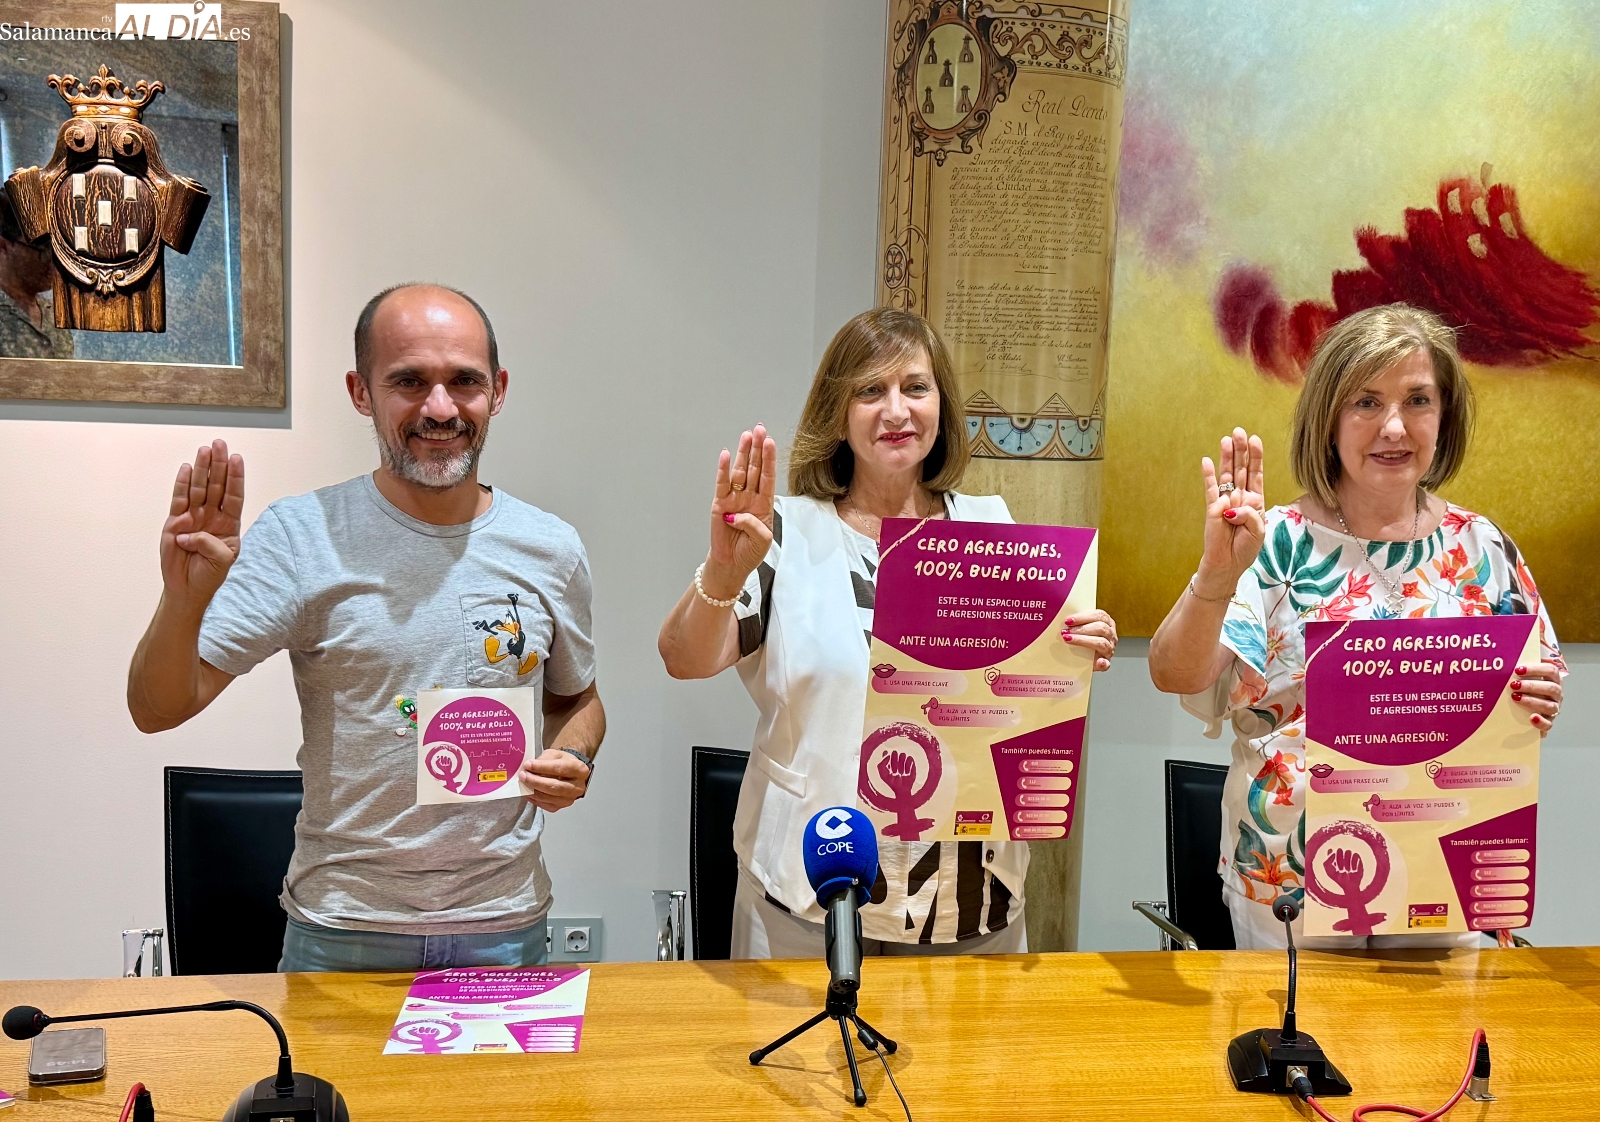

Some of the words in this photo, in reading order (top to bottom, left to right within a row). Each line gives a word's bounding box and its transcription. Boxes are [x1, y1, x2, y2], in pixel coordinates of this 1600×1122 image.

[1022, 90, 1065, 124] Real
[997, 181, 1031, 191] Ciudad
[917, 538, 958, 553] CERO
[964, 540, 1061, 558] AGRESIONES,
[914, 560, 963, 581] 100%
[969, 564, 1011, 581] BUEN
[1017, 567, 1066, 582] ROLLO
[938, 596, 957, 604] ESTE
[986, 598, 1020, 608] ESPACIO
[1022, 600, 1046, 608] LIBRE
[950, 610, 1001, 619] AGRESIONES
[1003, 612, 1043, 620] SEXUALES
[900, 636, 926, 646] ANTE
[929, 637, 950, 646] UNA
[953, 637, 1008, 648] AGRESIÓN:
[1344, 637, 1386, 653] CERO
[1392, 634, 1496, 651] AGRESIONES,
[1343, 659, 1393, 678] 100%
[1400, 660, 1444, 675] BUEN
[1450, 657, 1503, 674] ROLLO
[1420, 692, 1456, 700] ESPACIO
[1459, 691, 1484, 700] LIBRE
[1383, 706, 1438, 714] AGRESIONES
[1440, 704, 1482, 712] SEXUALES
[439, 722, 463, 731] 100%
[1334, 734, 1362, 745] ANTE
[1365, 734, 1387, 744] UNA
[1390, 731, 1448, 743] AGRESIÓN:
[818, 842, 854, 856] COPE
